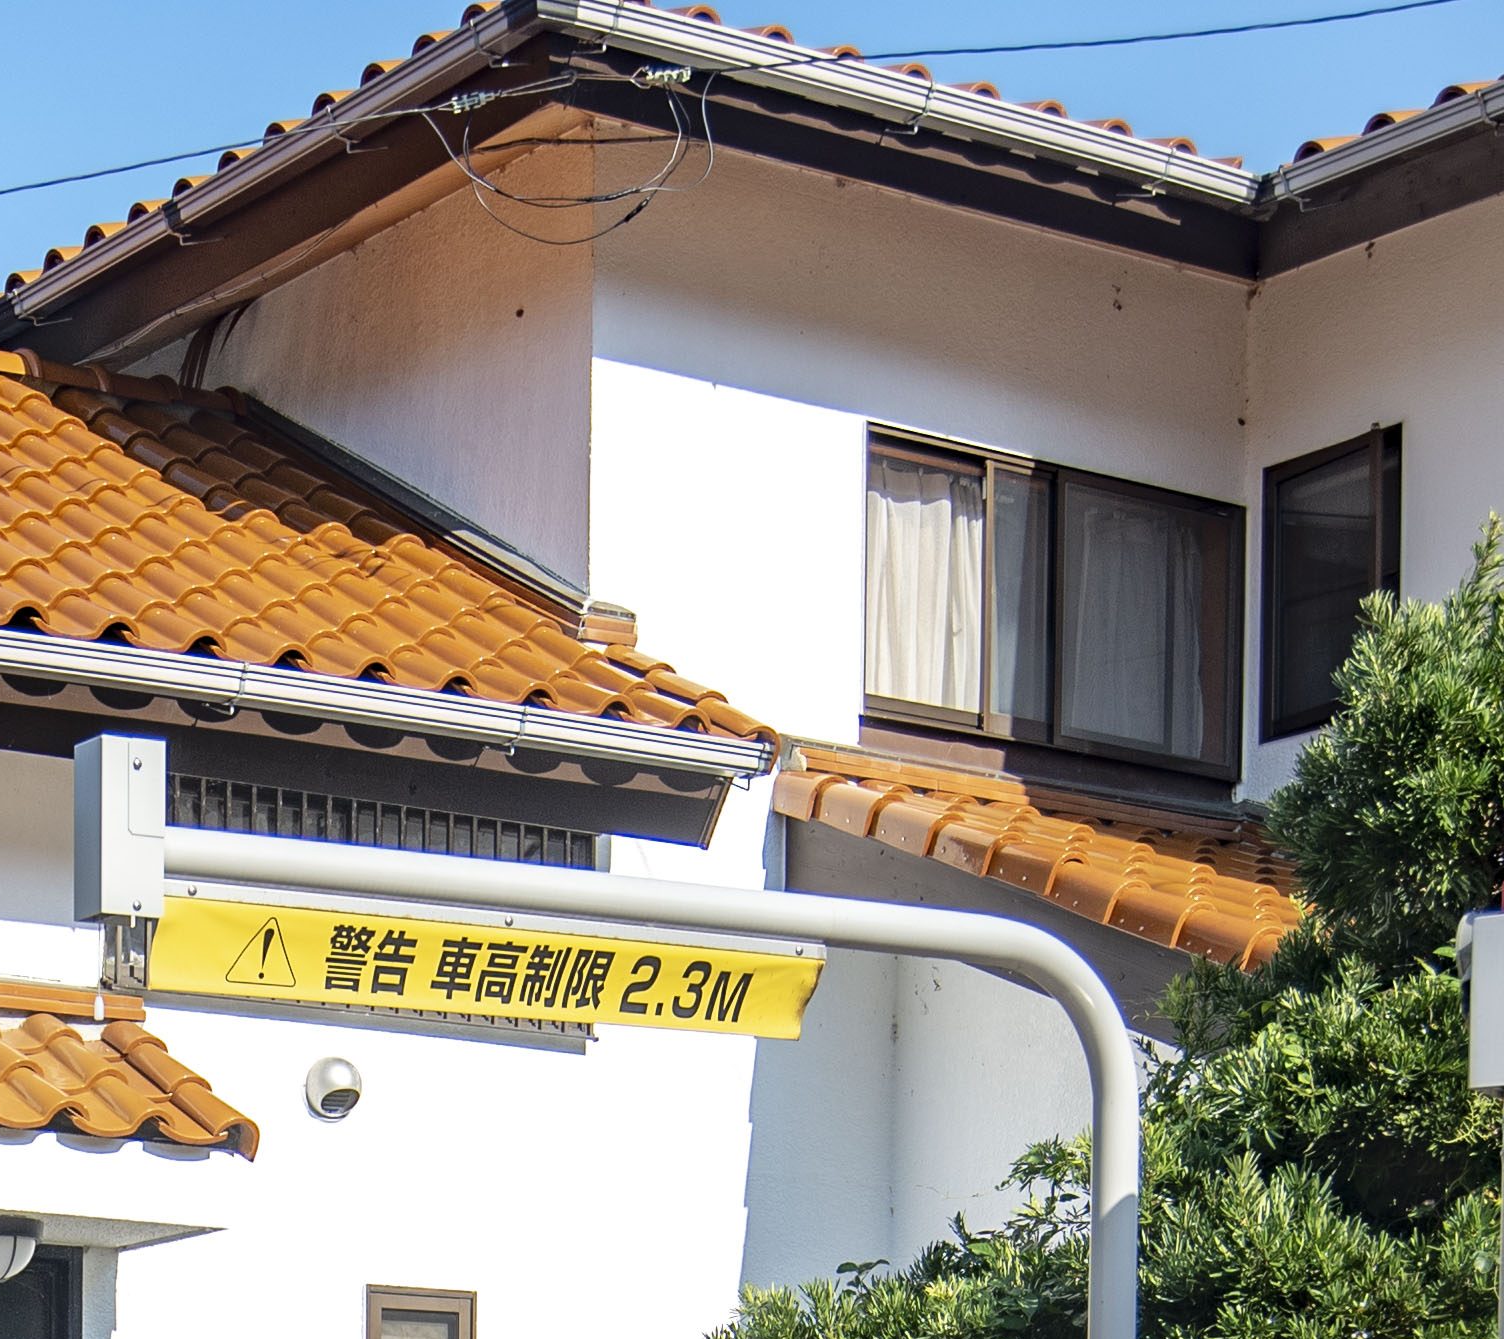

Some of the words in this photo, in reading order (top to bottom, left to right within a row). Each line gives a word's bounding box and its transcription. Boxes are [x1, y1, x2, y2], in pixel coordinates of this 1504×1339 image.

[324, 925, 419, 996] 警告
[429, 936, 614, 1013] 車高制限
[617, 954, 755, 1023] 2.3M
